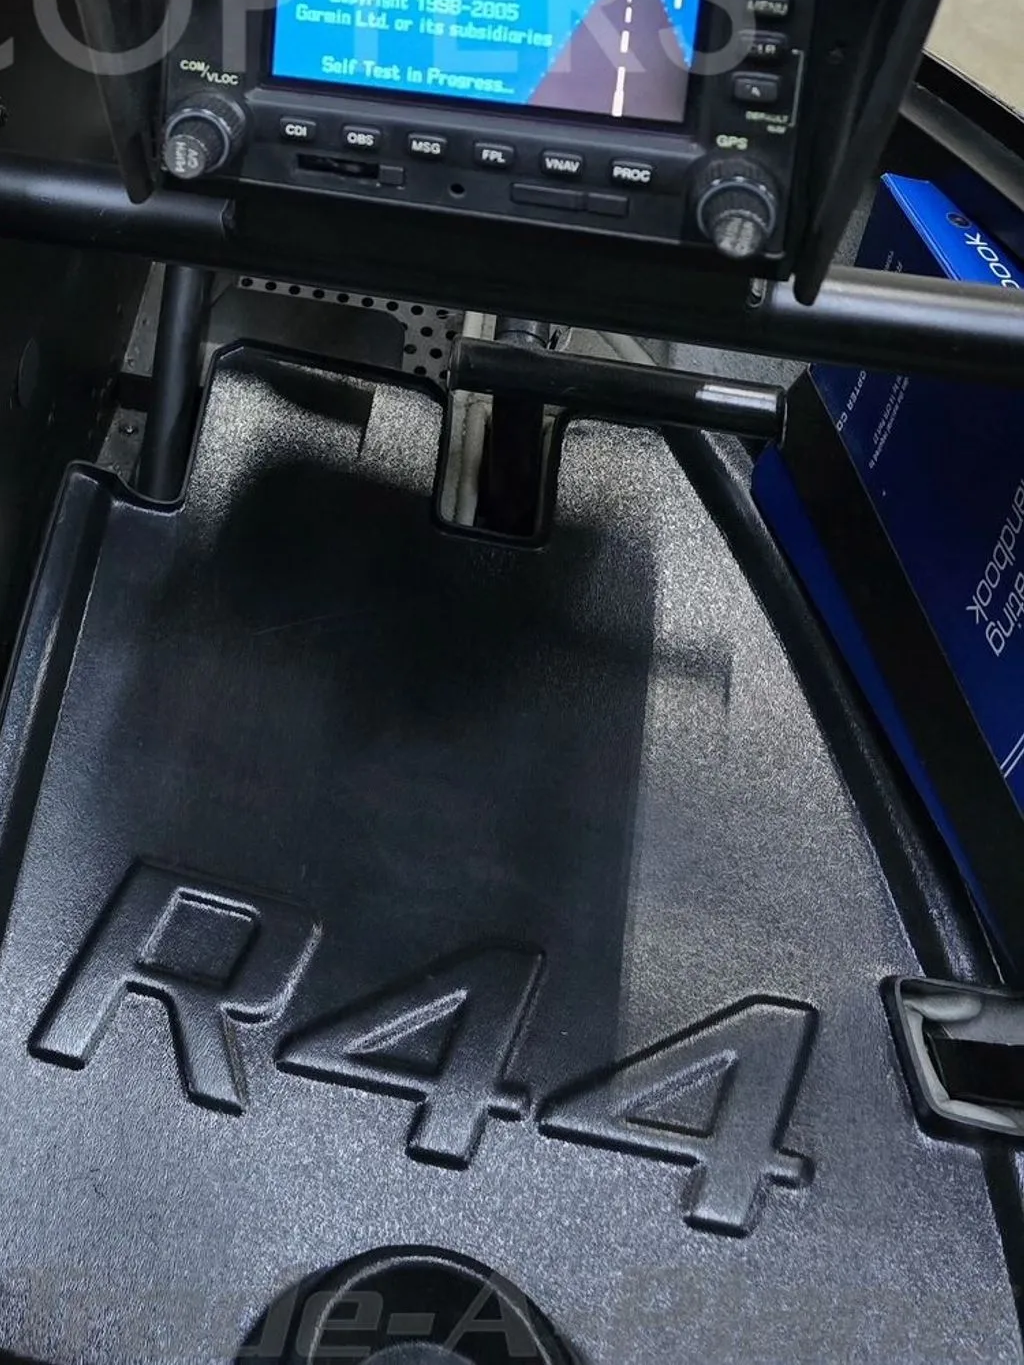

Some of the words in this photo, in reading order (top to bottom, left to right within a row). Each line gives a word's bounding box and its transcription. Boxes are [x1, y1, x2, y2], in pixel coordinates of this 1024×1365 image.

[295, 3, 352, 26] Garmin
[355, 9, 389, 30] Ltd.
[394, 18, 413, 32] or
[419, 17, 445, 36] its
[449, 22, 553, 47] subsidiaries
[321, 55, 358, 75] Self
[363, 60, 400, 81] Test
[407, 65, 423, 83] in
[285, 123, 308, 137] CDI
[347, 132, 374, 146] OBS
[411, 139, 441, 155] MSG
[715, 134, 749, 150] GPS
[481, 149, 506, 164] FPL
[545, 157, 581, 174] VNAV
[612, 166, 651, 183] PROC
[966, 479, 1024, 624] andbook
[26, 856, 821, 1239] R44
